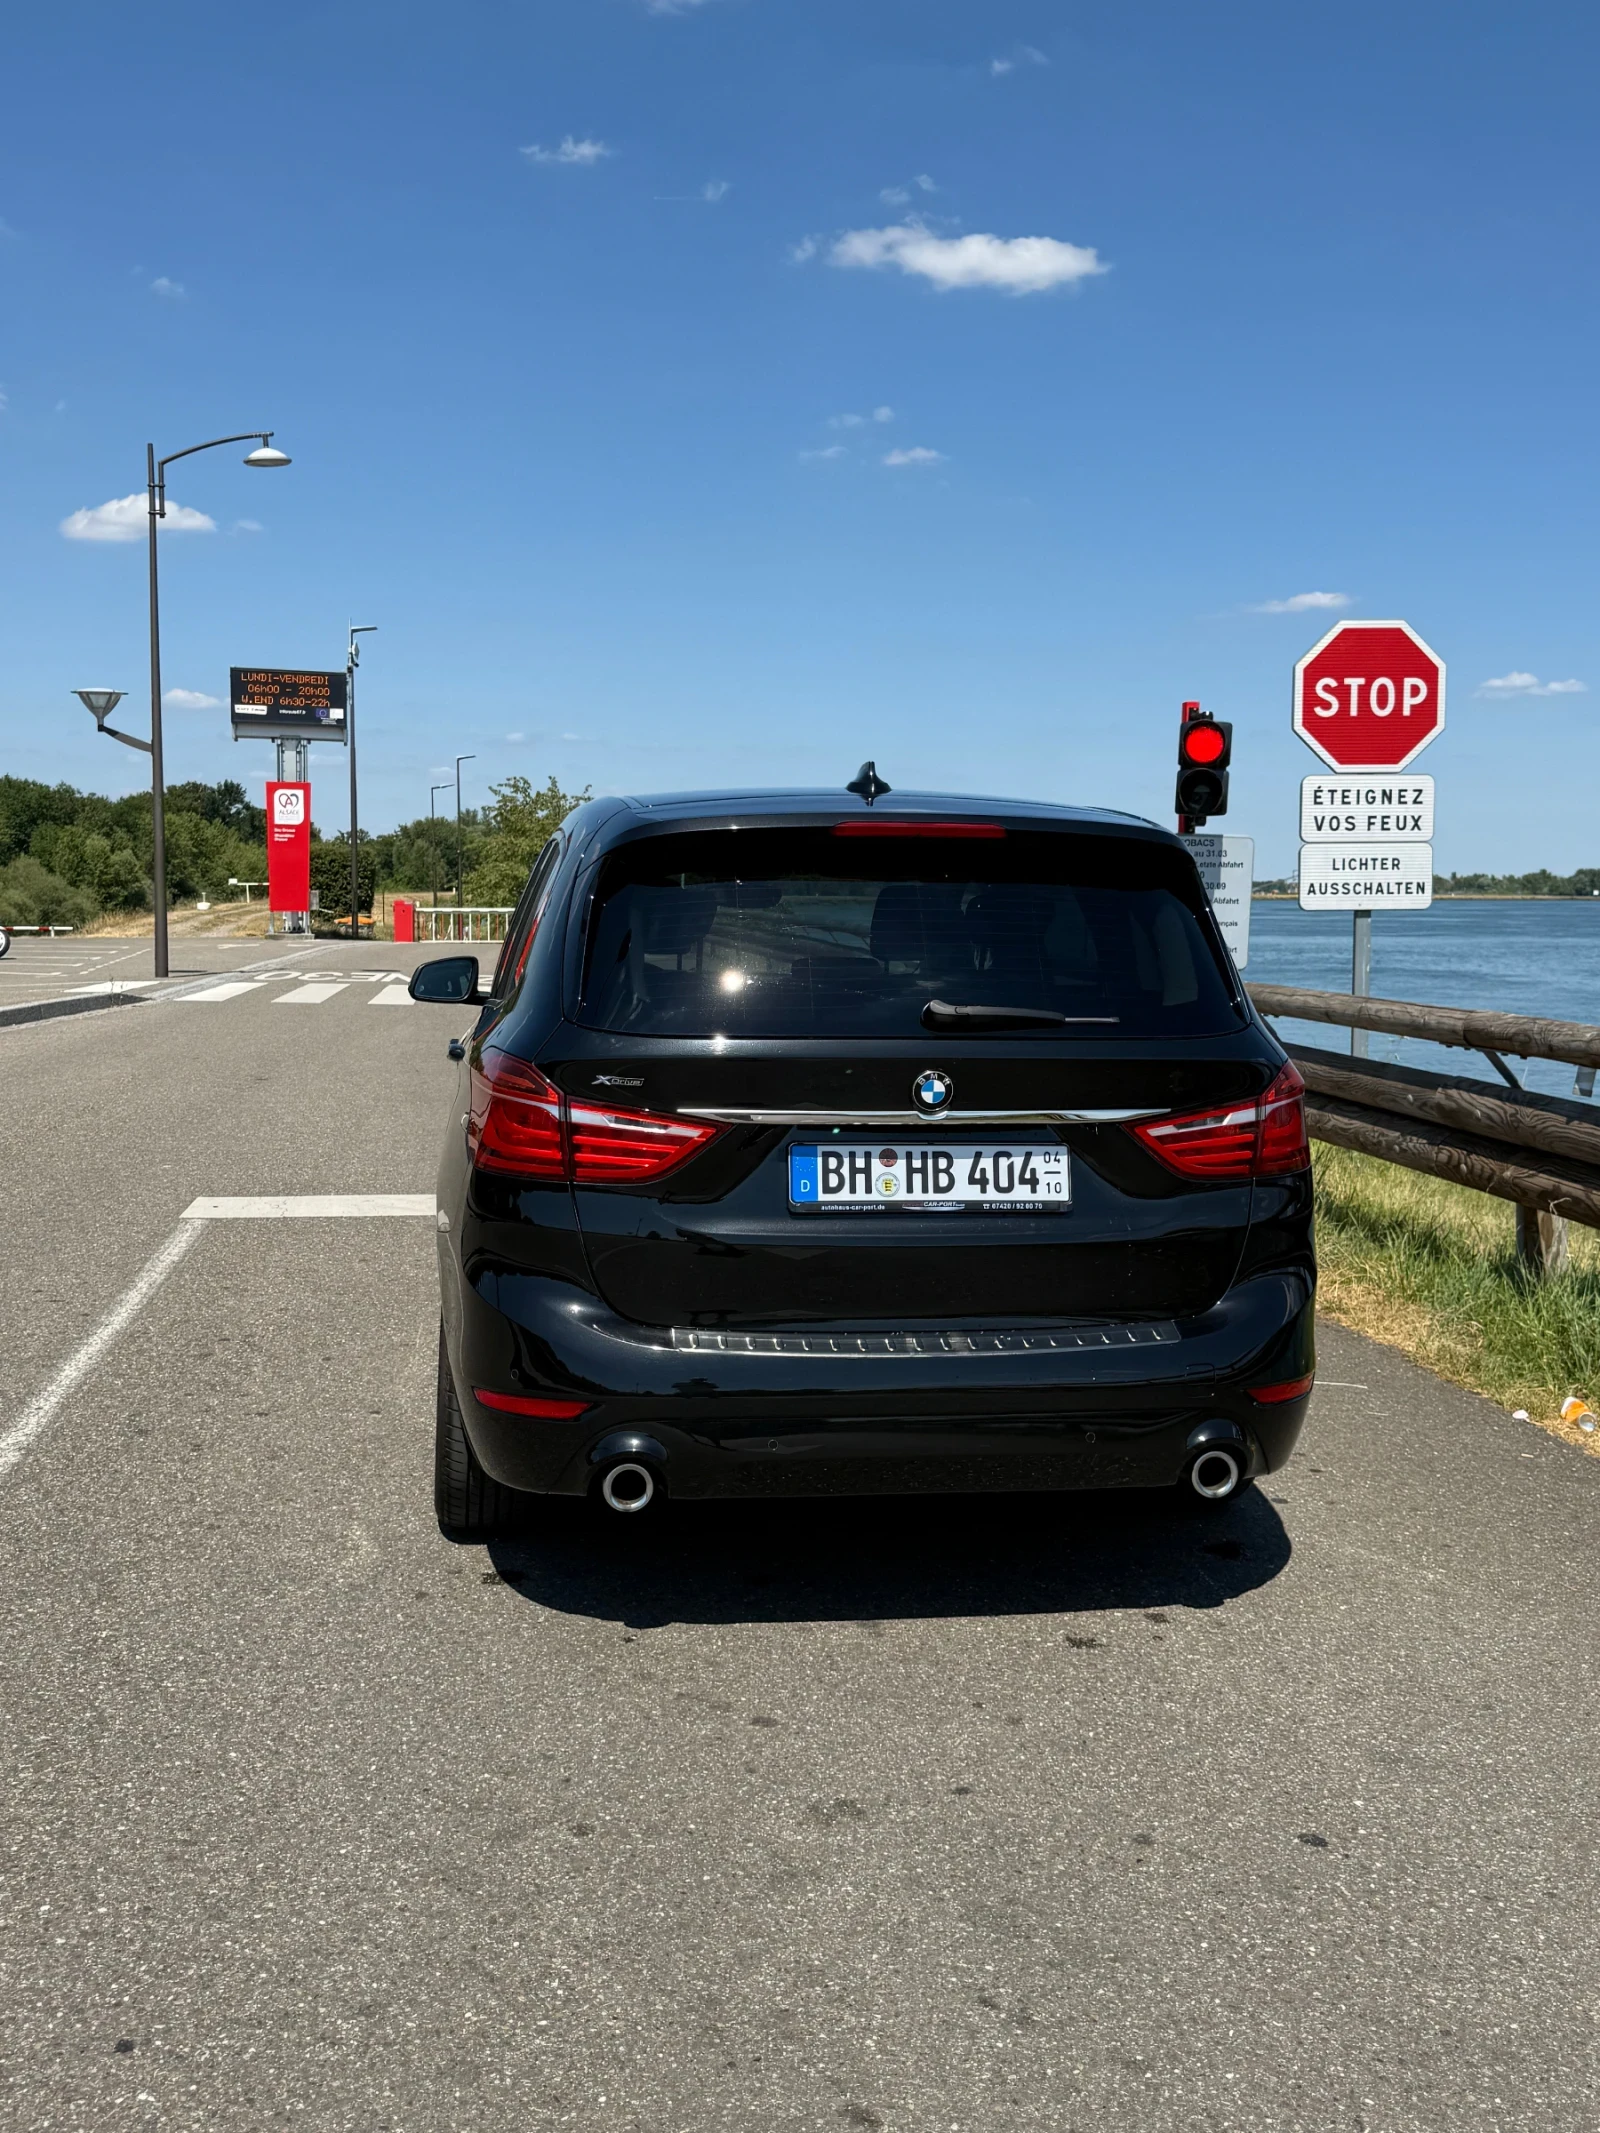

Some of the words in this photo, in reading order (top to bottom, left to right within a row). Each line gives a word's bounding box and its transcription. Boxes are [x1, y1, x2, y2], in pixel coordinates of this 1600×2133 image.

[241, 672, 329, 685] LUNDI-VENDREDI
[247, 684, 280, 694] 06h00
[298, 686, 330, 696] 20h00
[241, 695, 274, 705] W.END
[280, 697, 330, 707] 6h30-22h
[1313, 677, 1428, 718] STOP
[1313, 786, 1424, 806] ÉTEIGNEZ
[1314, 815, 1356, 832] VOS
[1367, 815, 1423, 832] FEUX
[1182, 838, 1215, 847] OBACS
[1206, 850, 1228, 858] 31.03
[1218, 861, 1244, 869] Abfahrt
[1332, 857, 1401, 871] LICHTER
[1205, 882, 1227, 890] 30.09
[1307, 881, 1426, 896] AUSSCHALTEN
[1213, 897, 1239, 905] Abfahrt
[1043, 1151, 1061, 1165] 04
[821, 1150, 873, 1194] BH
[905, 1150, 956, 1194] HB
[967, 1150, 1040, 1194] 404
[800, 1179, 811, 1192] D
[1046, 1181, 1062, 1194] 10
